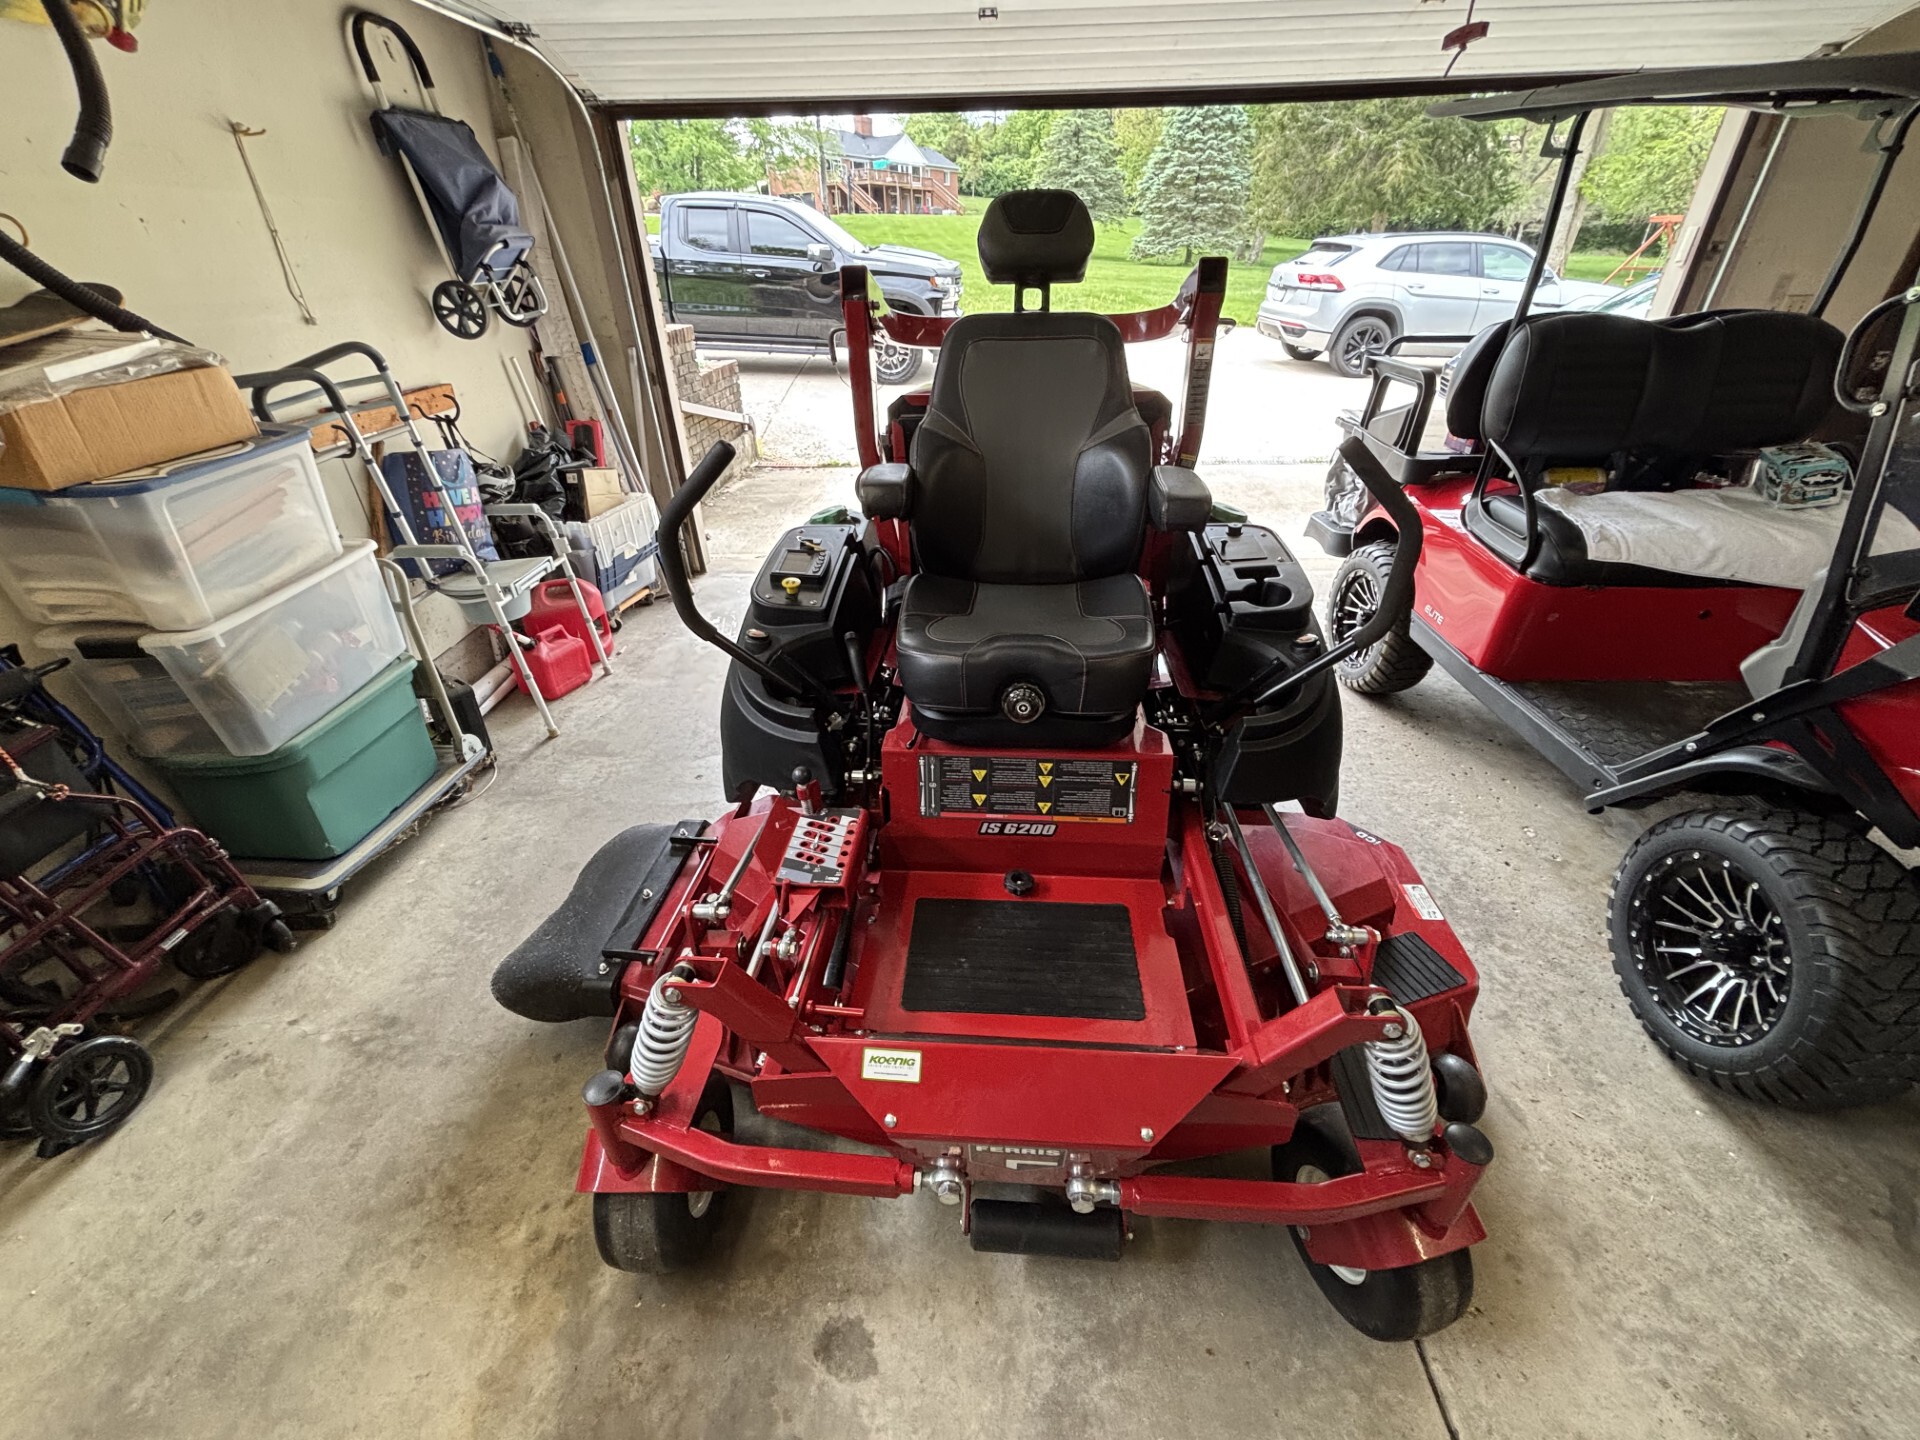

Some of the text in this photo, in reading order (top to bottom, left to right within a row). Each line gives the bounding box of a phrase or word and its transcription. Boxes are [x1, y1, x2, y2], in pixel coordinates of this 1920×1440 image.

[422, 488, 471, 508] HVE
[980, 822, 1057, 836] IS 6200
